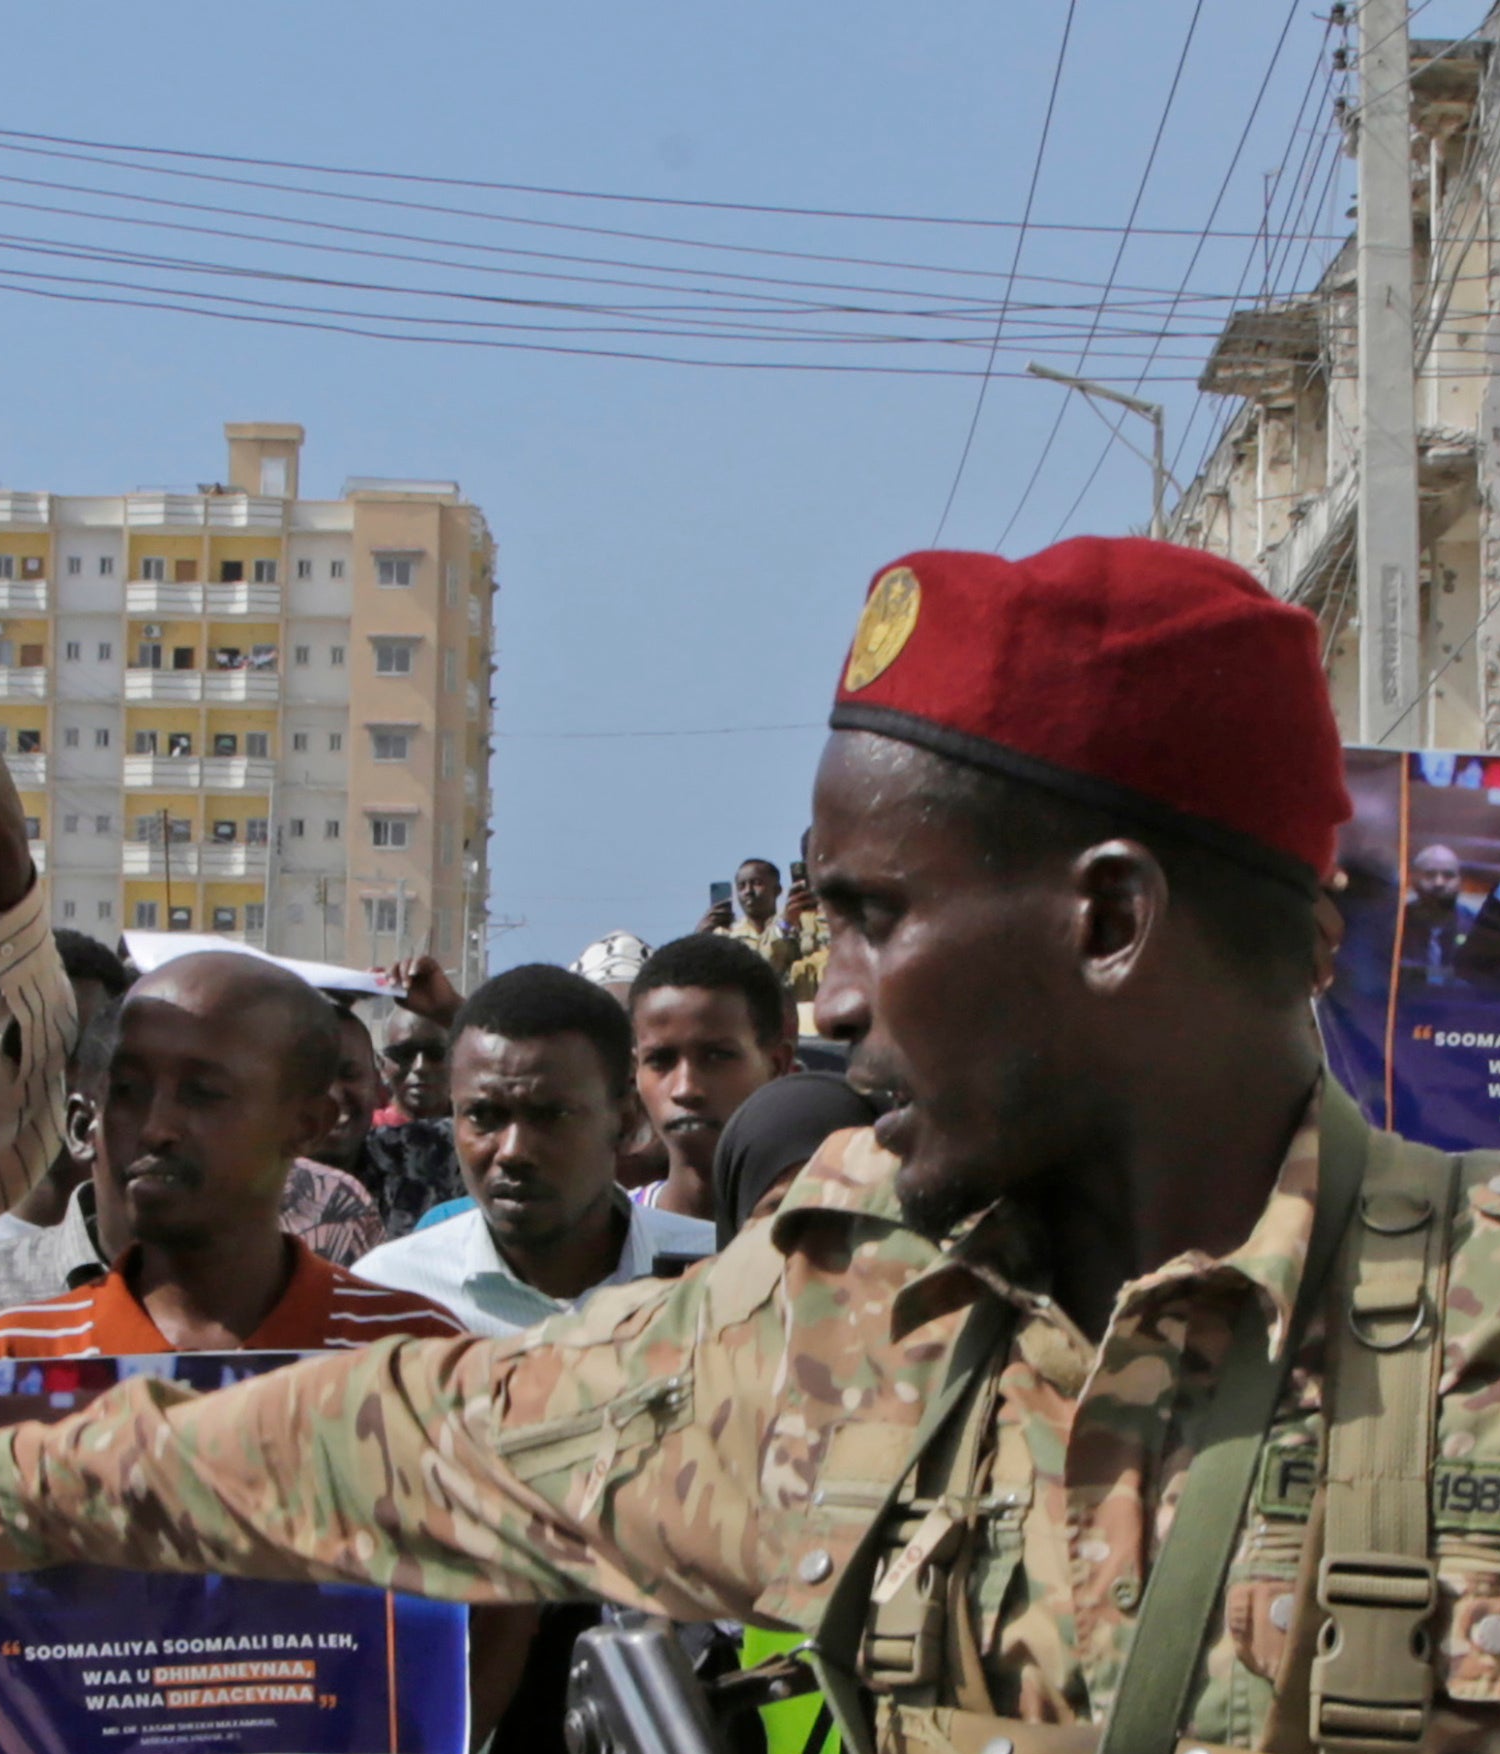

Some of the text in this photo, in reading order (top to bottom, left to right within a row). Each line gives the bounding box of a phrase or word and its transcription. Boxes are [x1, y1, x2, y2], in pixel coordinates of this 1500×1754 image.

[24, 1632, 359, 1661] SOOMAALIYA SOOMAALI BAA LEH,
[83, 1661, 315, 1686] WAA U DHIMANEYNAA,
[86, 1686, 314, 1711] WAANA DIFAACEYNAA
